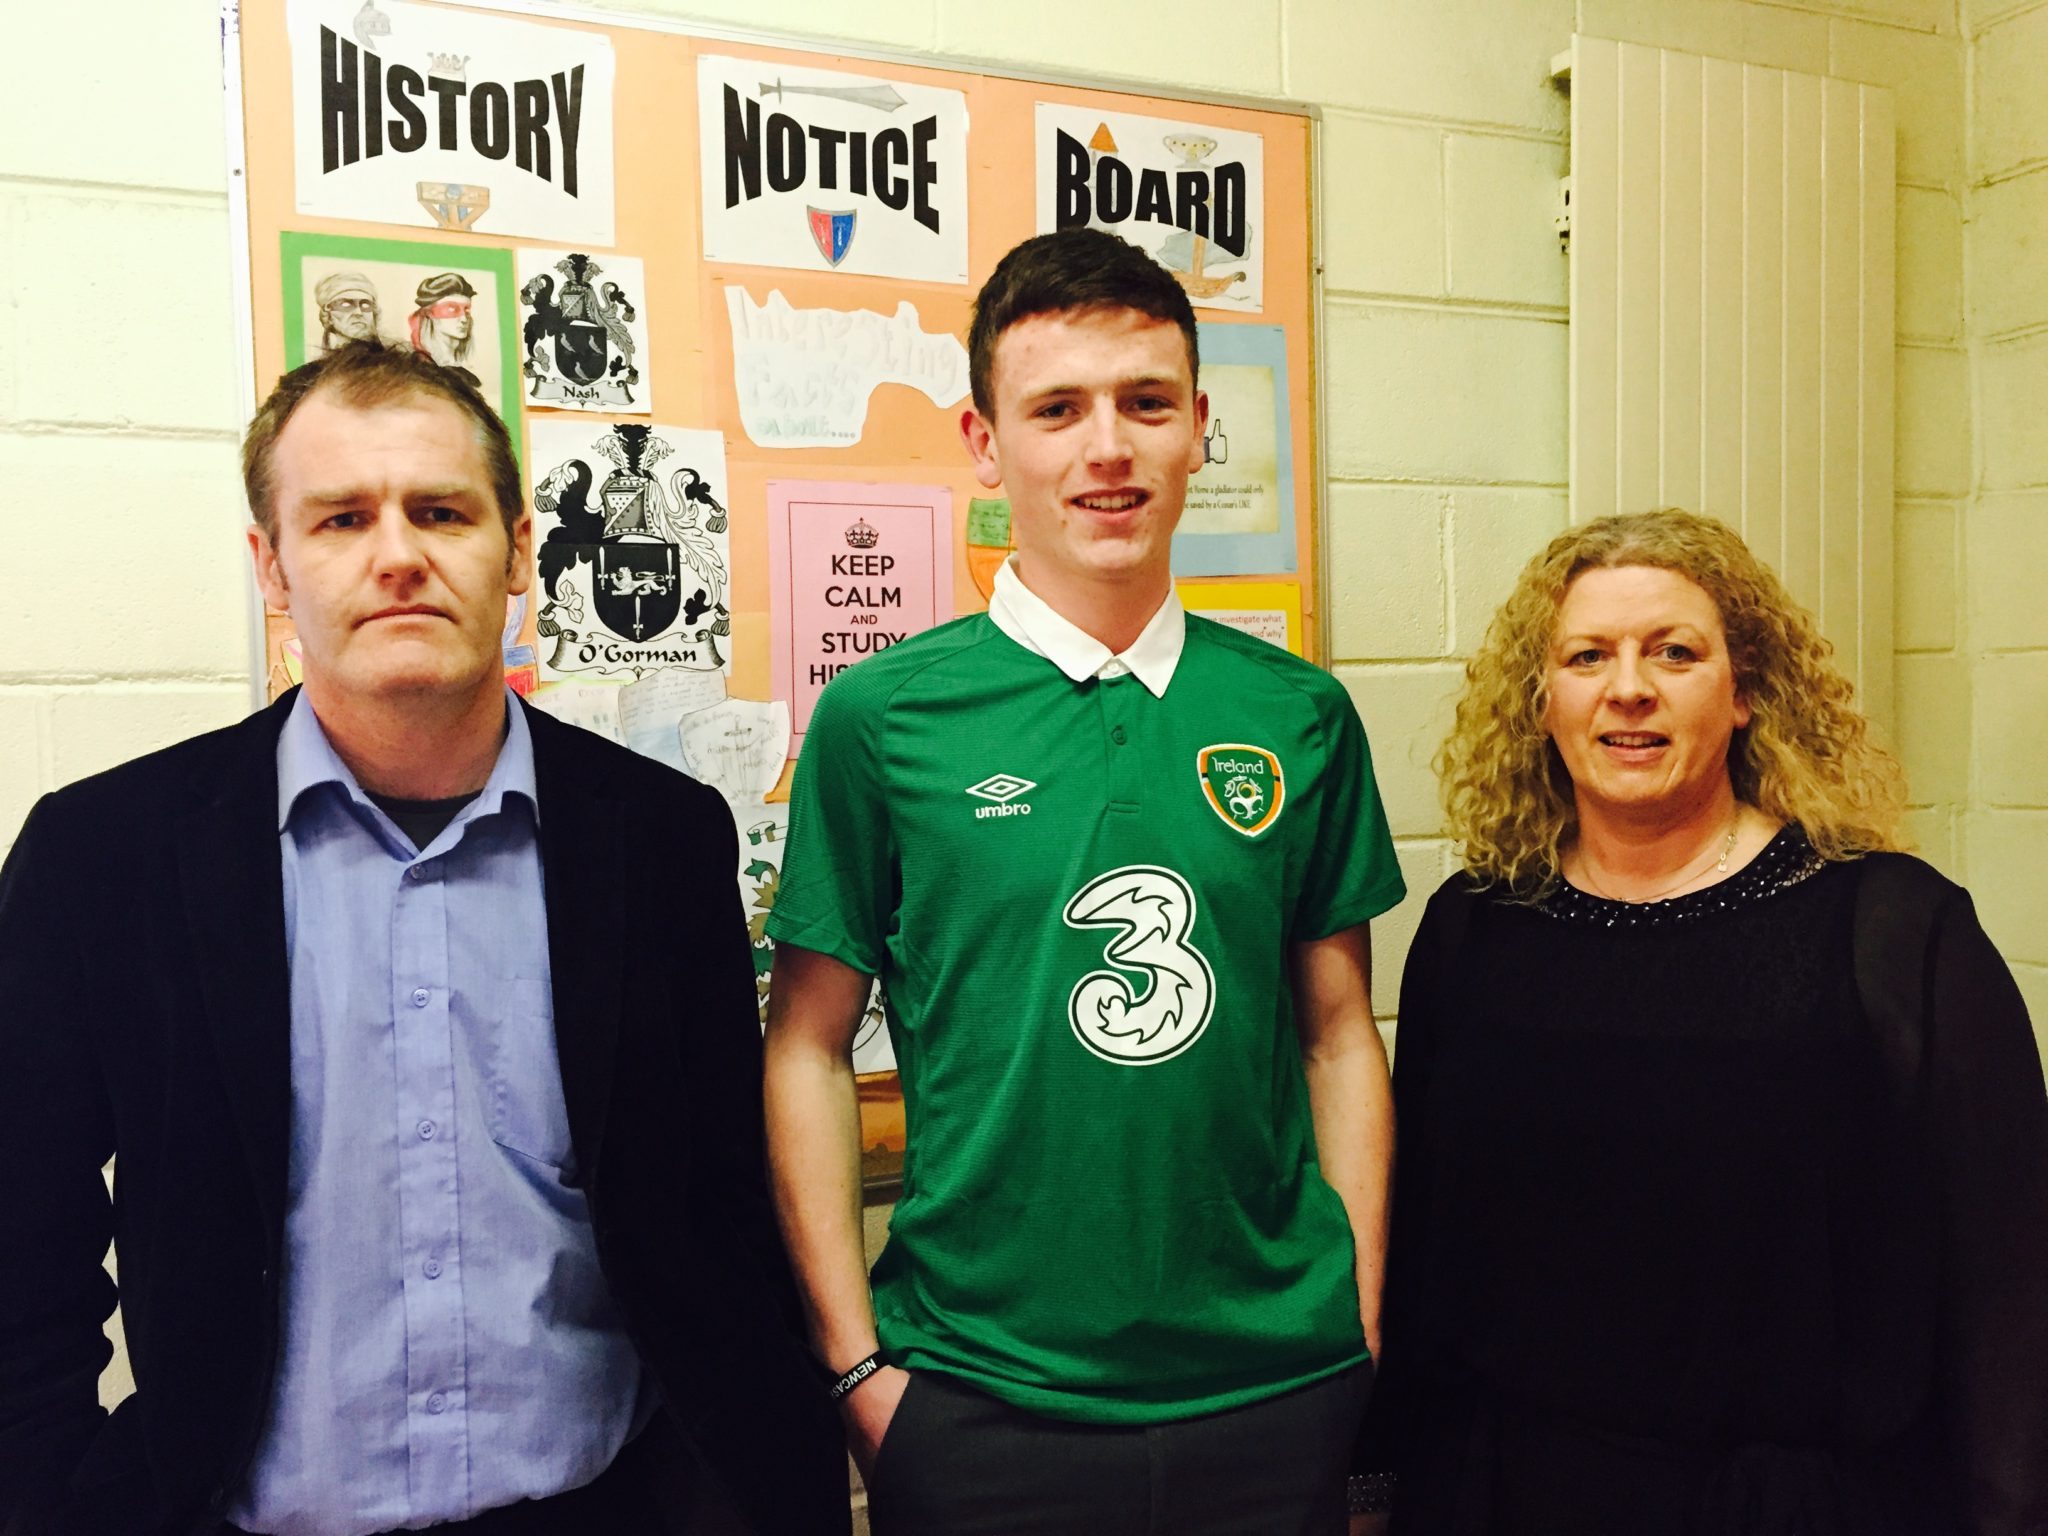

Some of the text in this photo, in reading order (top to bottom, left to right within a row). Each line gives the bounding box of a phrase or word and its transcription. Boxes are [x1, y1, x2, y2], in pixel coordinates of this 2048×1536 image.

[320, 23, 1246, 258] HISTORY NOTICE BOARD
[563, 385, 601, 400] Nash
[832, 554, 895, 576] KEEP
[824, 586, 902, 608] CALM
[850, 614, 878, 625] AND
[1219, 615, 1261, 625] investigate
[1262, 613, 1282, 623] what
[1266, 629, 1282, 639] why
[578, 643, 697, 664] O'Gorman
[1212, 756, 1264, 775] Ireland
[975, 802, 1031, 819] umbro
[1063, 864, 1216, 1066] 3
